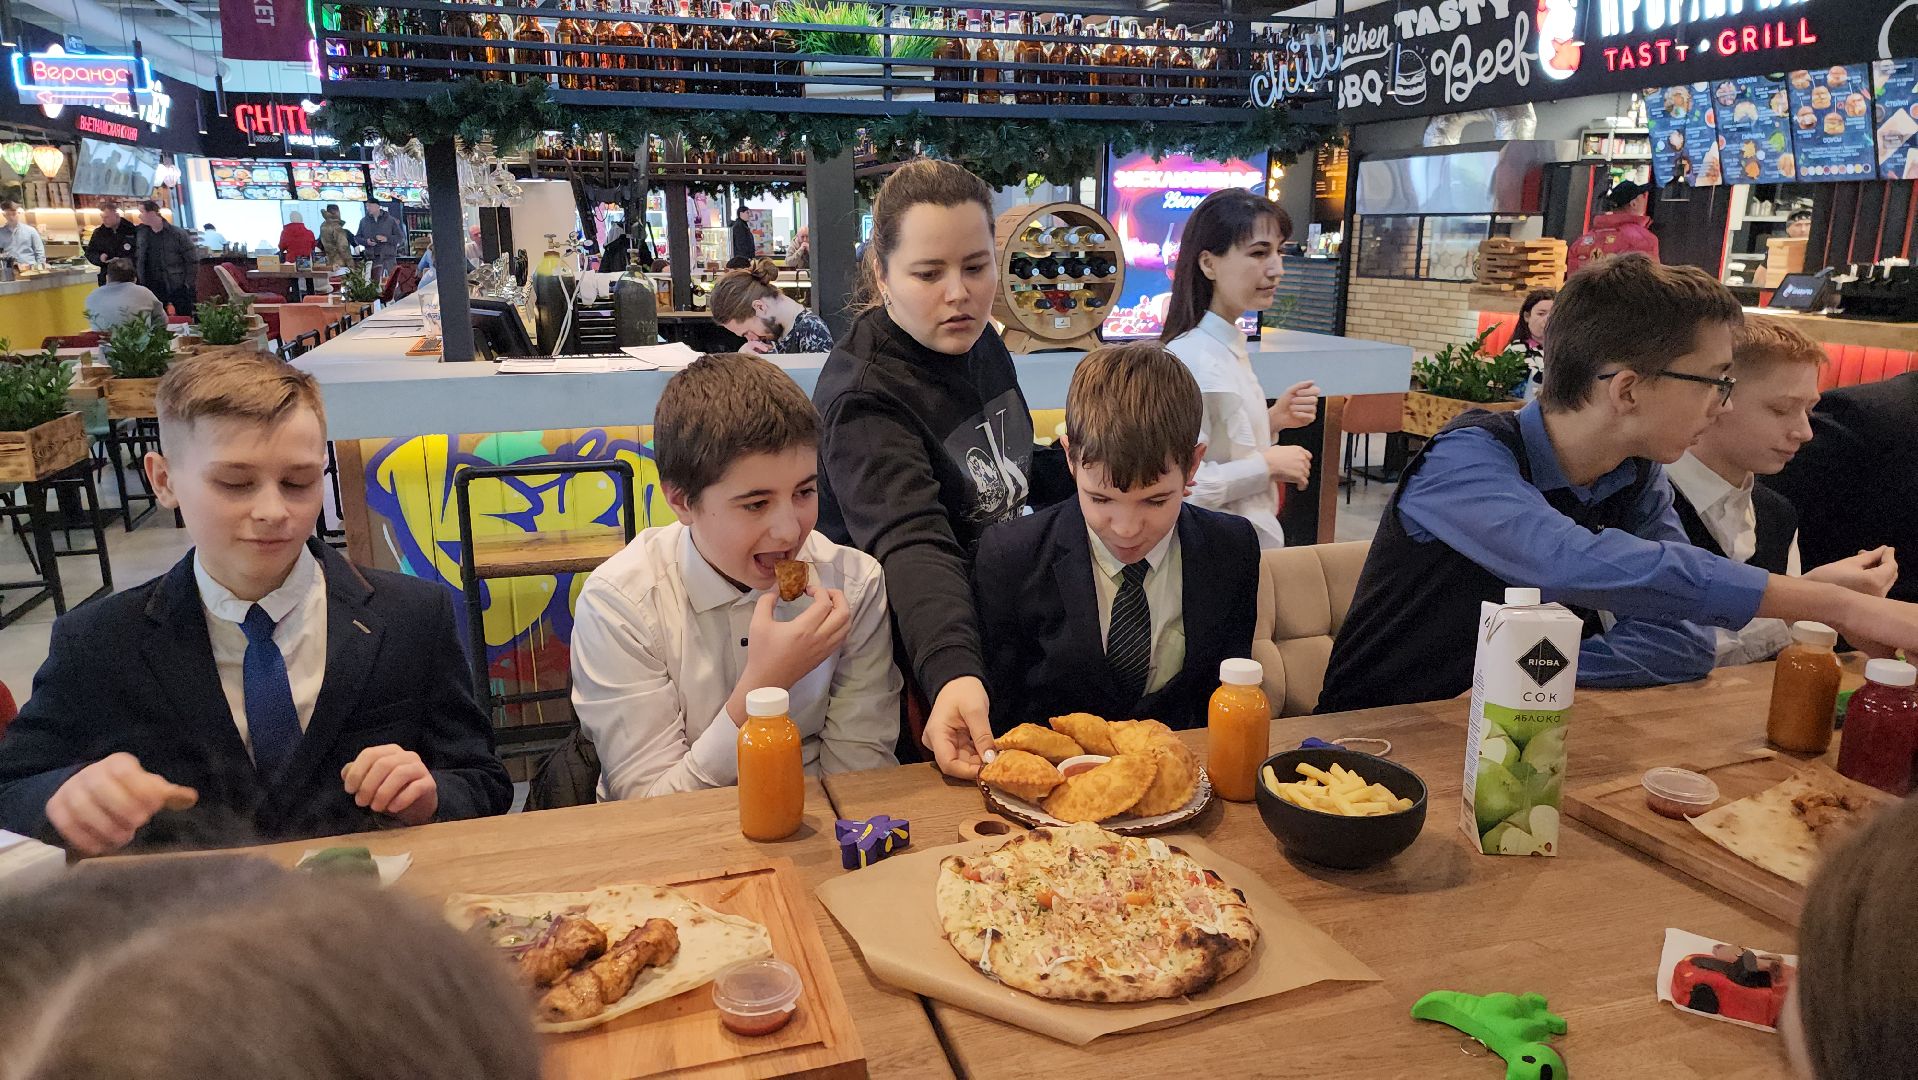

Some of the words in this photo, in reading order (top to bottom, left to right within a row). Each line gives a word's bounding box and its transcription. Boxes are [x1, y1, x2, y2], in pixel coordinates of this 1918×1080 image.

[1394, 0, 1510, 39] TASTY
[1341, 21, 1394, 57] icken
[1717, 17, 1818, 56] GRILL
[32, 60, 130, 86] Веранда
[1430, 11, 1537, 104] Beef
[1528, 658, 1561, 667] RIOBA
[1522, 691, 1558, 703] СОК
[1513, 713, 1561, 724] ЯБЛОКО
